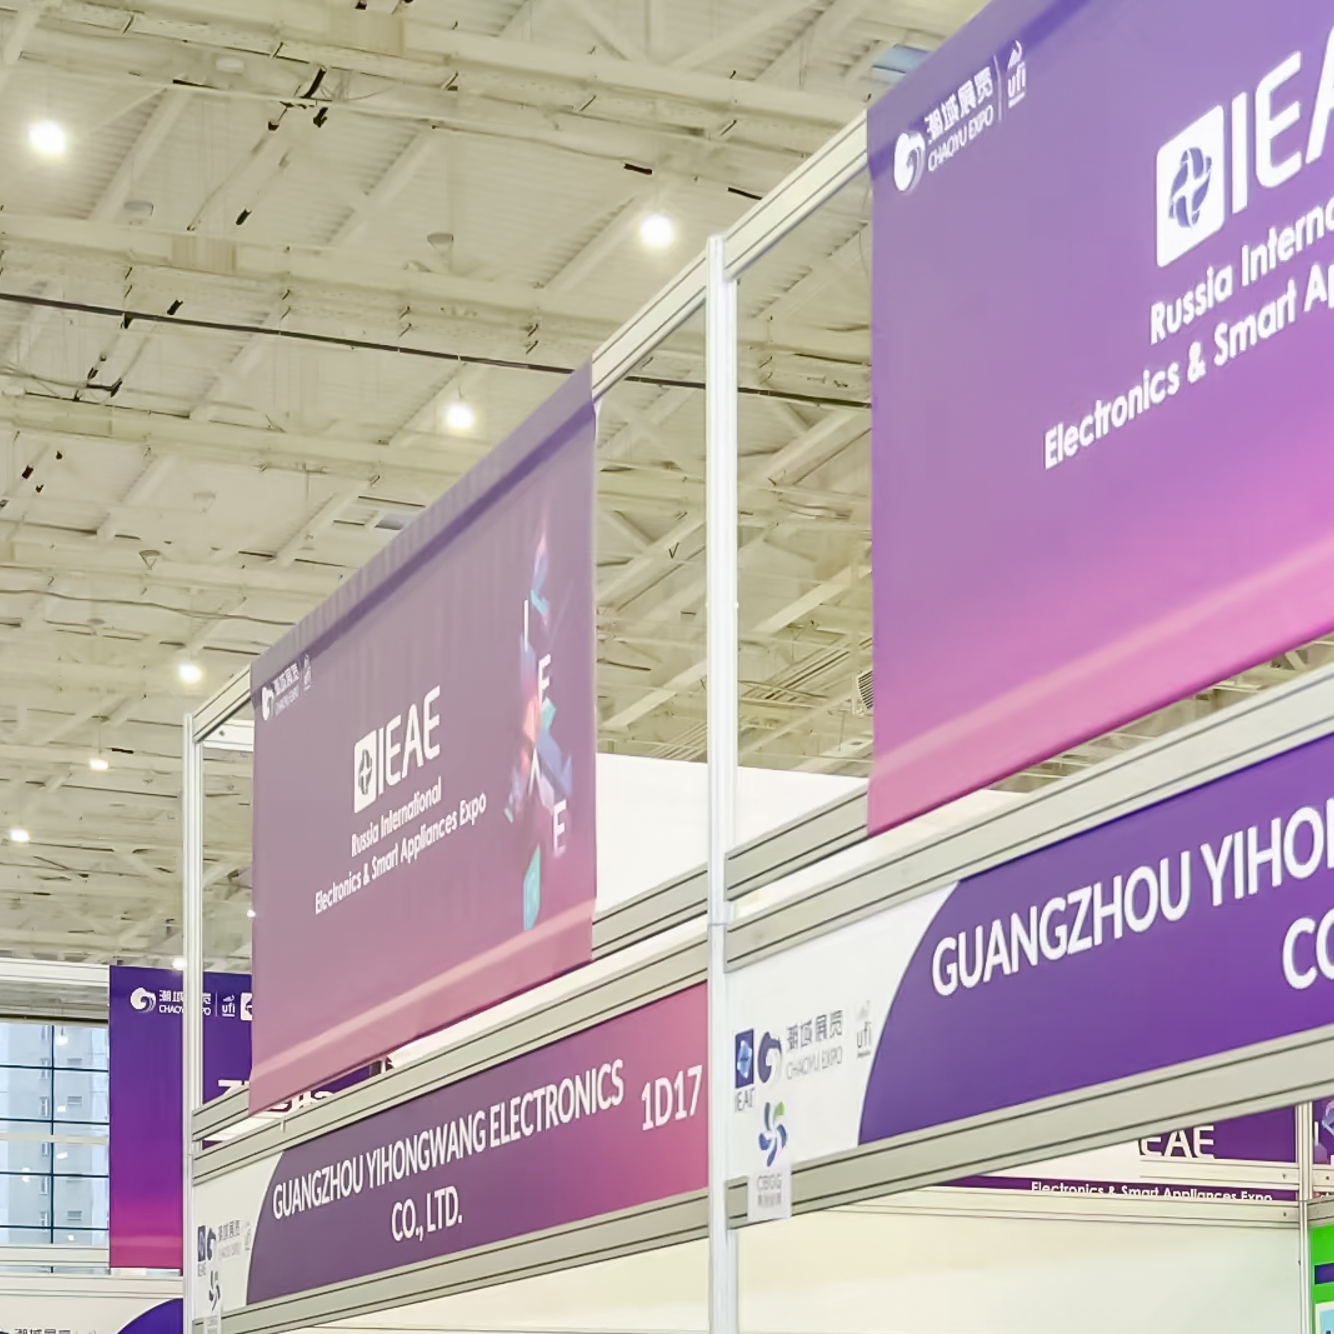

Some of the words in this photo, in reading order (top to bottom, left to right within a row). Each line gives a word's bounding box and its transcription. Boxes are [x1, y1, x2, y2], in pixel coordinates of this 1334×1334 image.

[968, 104, 994, 141] EXPO
[1150, 265, 1233, 345] Russia
[1044, 361, 1181, 469] Electronics
[1186, 341, 1206, 384] &
[1213, 278, 1298, 366] Smart
[378, 685, 441, 796] IEAE
[315, 870, 362, 915] Electronics
[363, 862, 371, 887] &
[372, 843, 399, 880] Smart
[400, 811, 458, 864] Appliances
[459, 792, 487, 832] Expo
[351, 822, 379, 858] Russia
[381, 776, 442, 839] International
[932, 850, 1192, 996] GUANGZHOU
[222, 1002, 236, 1014] ufi
[821, 1046, 843, 1069] EXPO
[641, 1065, 703, 1131] 1D17
[272, 1154, 364, 1220] GUANGZHOU
[366, 1110, 486, 1190] YIHONGWANG
[489, 1059, 624, 1149] ELECTRONICS
[391, 1202, 424, 1242] CO.,
[426, 1186, 463, 1233] LTD.
[1031, 1181, 1103, 1194] Electronics
[1121, 1185, 1159, 1197] Smart
[1164, 1187, 1237, 1199] Appliances
[1240, 1191, 1273, 1201] Expo
